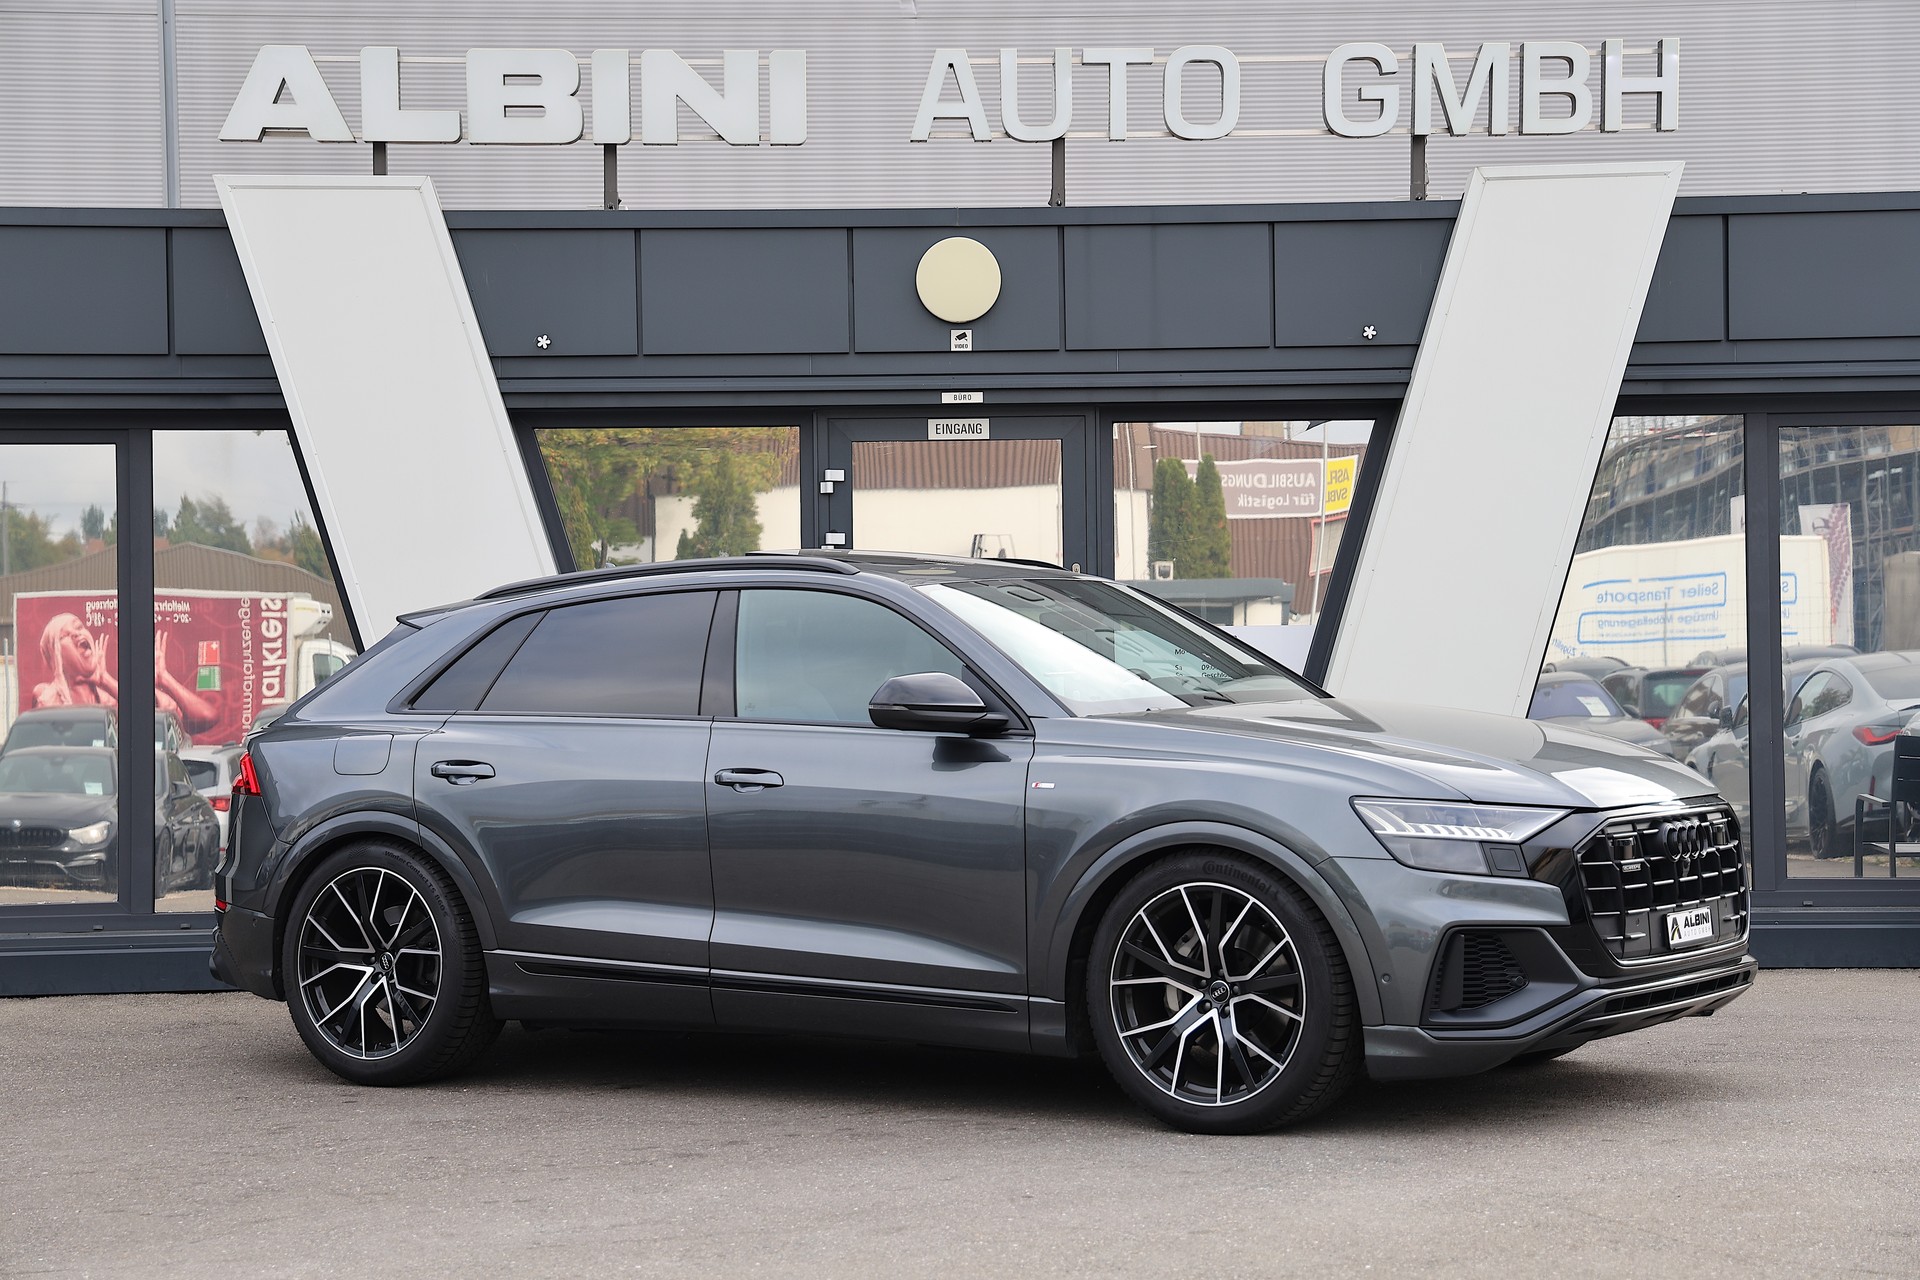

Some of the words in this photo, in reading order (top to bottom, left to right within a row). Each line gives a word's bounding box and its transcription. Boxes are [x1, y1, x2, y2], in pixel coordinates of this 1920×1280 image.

[218, 44, 807, 145] ALBINI
[910, 45, 1242, 143] AUTO
[1323, 37, 1680, 138] GMBH
[953, 392, 972, 401] BÜRO
[935, 423, 983, 435] EINGANG
[1202, 860, 1272, 894] Continental
[1684, 911, 1710, 928] ALBINI
